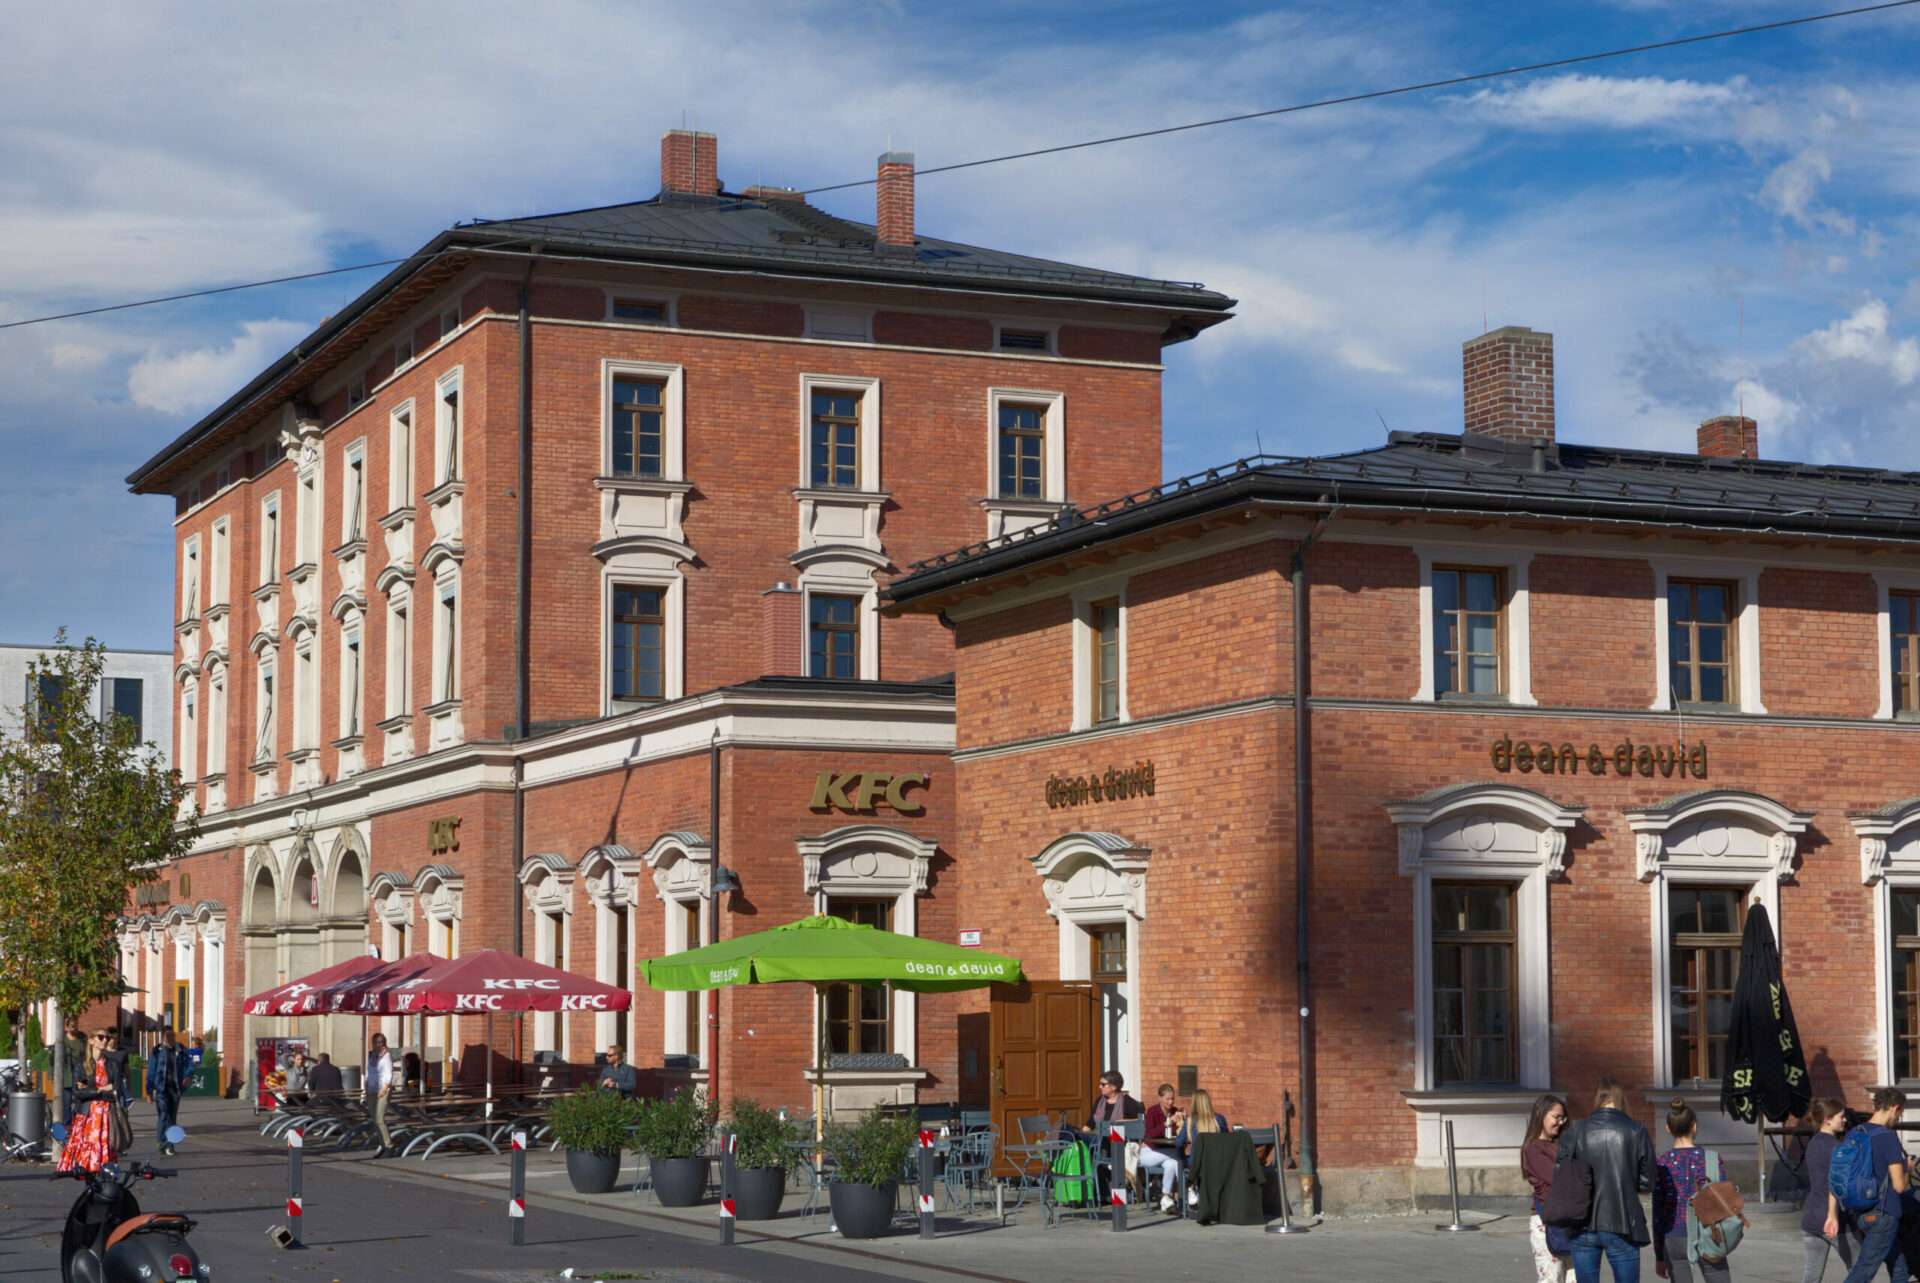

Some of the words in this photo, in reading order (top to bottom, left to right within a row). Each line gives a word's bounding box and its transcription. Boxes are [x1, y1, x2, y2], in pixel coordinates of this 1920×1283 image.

[1491, 733, 1579, 775] dean
[1586, 743, 1606, 776] &
[1612, 737, 1708, 779] david
[809, 770, 931, 816] KFC
[905, 961, 944, 977] dean
[959, 962, 1005, 976] david
[483, 978, 561, 990] KFC
[455, 994, 504, 1010] KFC
[560, 994, 608, 1010] KFC
